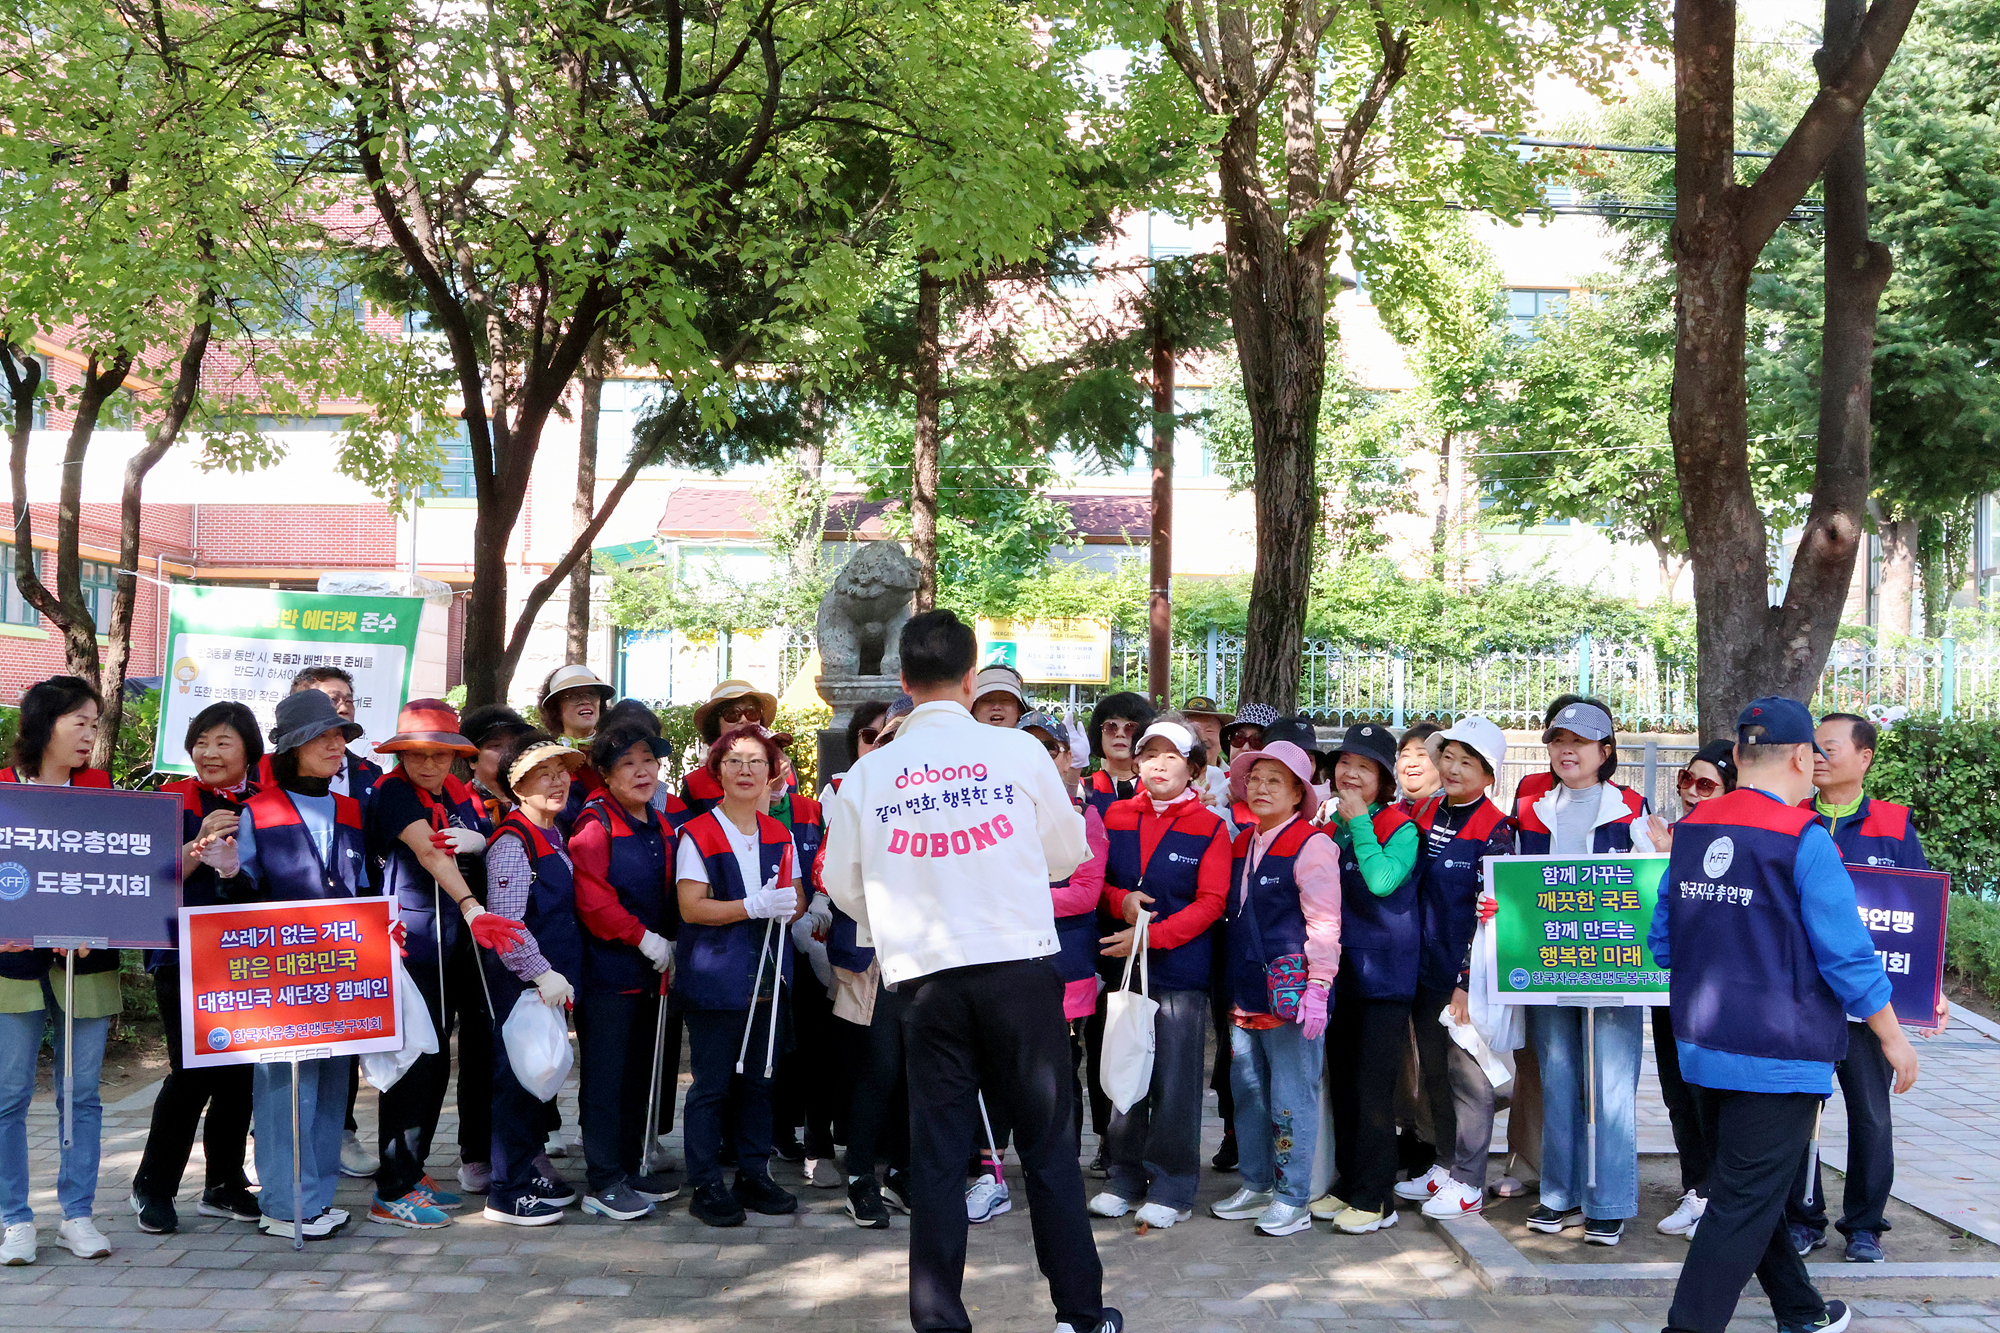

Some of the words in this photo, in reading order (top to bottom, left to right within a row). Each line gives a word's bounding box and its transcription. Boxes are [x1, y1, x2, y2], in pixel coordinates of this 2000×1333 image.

[302, 609, 357, 632] 에티켓
[360, 612, 397, 633] 준수
[234, 649, 255, 662] 동반
[257, 651, 269, 664] 시,
[273, 652, 301, 665] 목줄과
[303, 654, 342, 667] 배변봉투
[344, 656, 373, 668] 준비를
[234, 665, 264, 678] 반드시
[194, 686, 212, 698] 또한
[215, 687, 256, 700] 반려동물의
[259, 690, 279, 702] 잦은
[895, 763, 988, 789] dobong
[875, 804, 902, 823] 같이
[942, 786, 988, 809] 행복한
[993, 784, 1014, 805] 도봉
[0, 827, 151, 856] 한국자유총연맹
[887, 814, 1014, 858] DOBONG
[36, 872, 150, 897] 도봉구지회
[1542, 865, 1577, 886] 함께
[1581, 865, 1634, 885] 가꾸는
[1537, 890, 1596, 912] 깨끗한
[1600, 890, 1641, 912] 국토
[1680, 881, 1753, 906] 한국자유총연맹
[220, 926, 276, 949] 쓰레기
[280, 924, 317, 945] 없는
[321, 920, 363, 943] 거리,
[1544, 921, 1579, 941] 함께
[1582, 921, 1636, 941] 만드는
[229, 956, 271, 981] 밝은
[276, 949, 358, 976] 대한민국
[1539, 945, 1598, 968] 행복한
[1602, 945, 1642, 967] 미래
[198, 988, 273, 1013] 대한민국
[277, 983, 331, 1006] 새단장
[335, 977, 389, 1001] 캠페인
[233, 1016, 382, 1044] 한국자유총연맹도봉구지회
